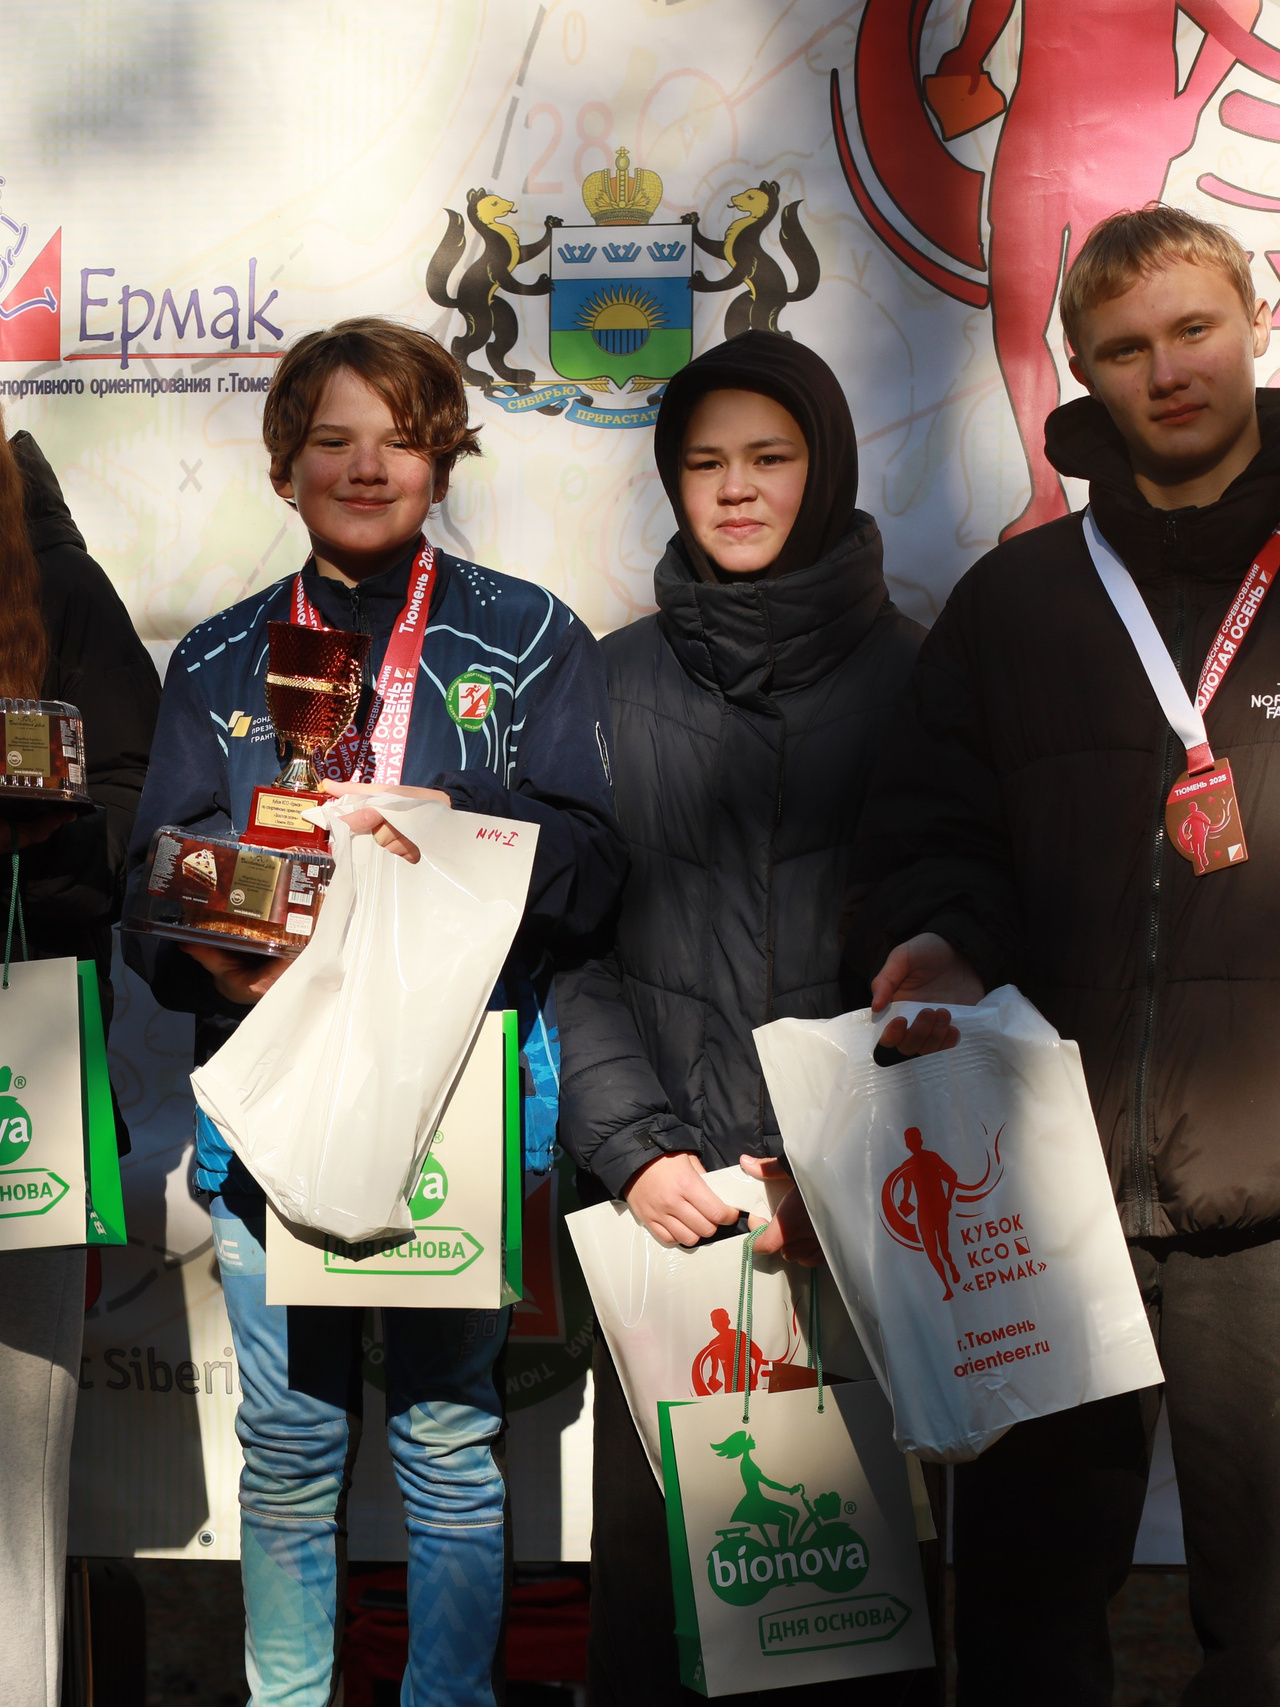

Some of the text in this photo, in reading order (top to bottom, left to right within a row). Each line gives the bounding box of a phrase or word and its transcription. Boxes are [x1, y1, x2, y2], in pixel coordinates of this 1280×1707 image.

[79, 257, 284, 370] Ермак
[90, 375, 211, 400] ориентирования
[217, 372, 274, 393] г.Тюме
[507, 386, 577, 411] СИБИРЬЮ
[575, 408, 660, 425] ПРИРАСТАТ
[398, 573, 429, 634] Тюмень
[1221, 563, 1260, 634] СОРЕВНОВАНИЯ
[1197, 584, 1265, 711] ОЛОТАЯ ОСЕНЬ
[364, 665, 393, 738] СОРЕВНОВАНИЯ
[375, 682, 402, 738] ОСЕНЬ
[392, 681, 413, 739] ОСЕНЬ
[1174, 773, 1227, 797] ТЮМЕНЬ 2025
[960, 1213, 1025, 1246] КУБОК
[381, 1241, 466, 1259] ОСНОВА
[967, 1242, 1010, 1269] КСО
[962, 1259, 1047, 1292] «ЕРМАК»
[957, 1319, 1036, 1352] г.Тюмень
[105, 1346, 244, 1396] Siberi
[953, 1340, 1051, 1378] orienteer.ru
[711, 1542, 868, 1588] bionova
[767, 1606, 897, 1643] ДНЯ ОСНОВА
